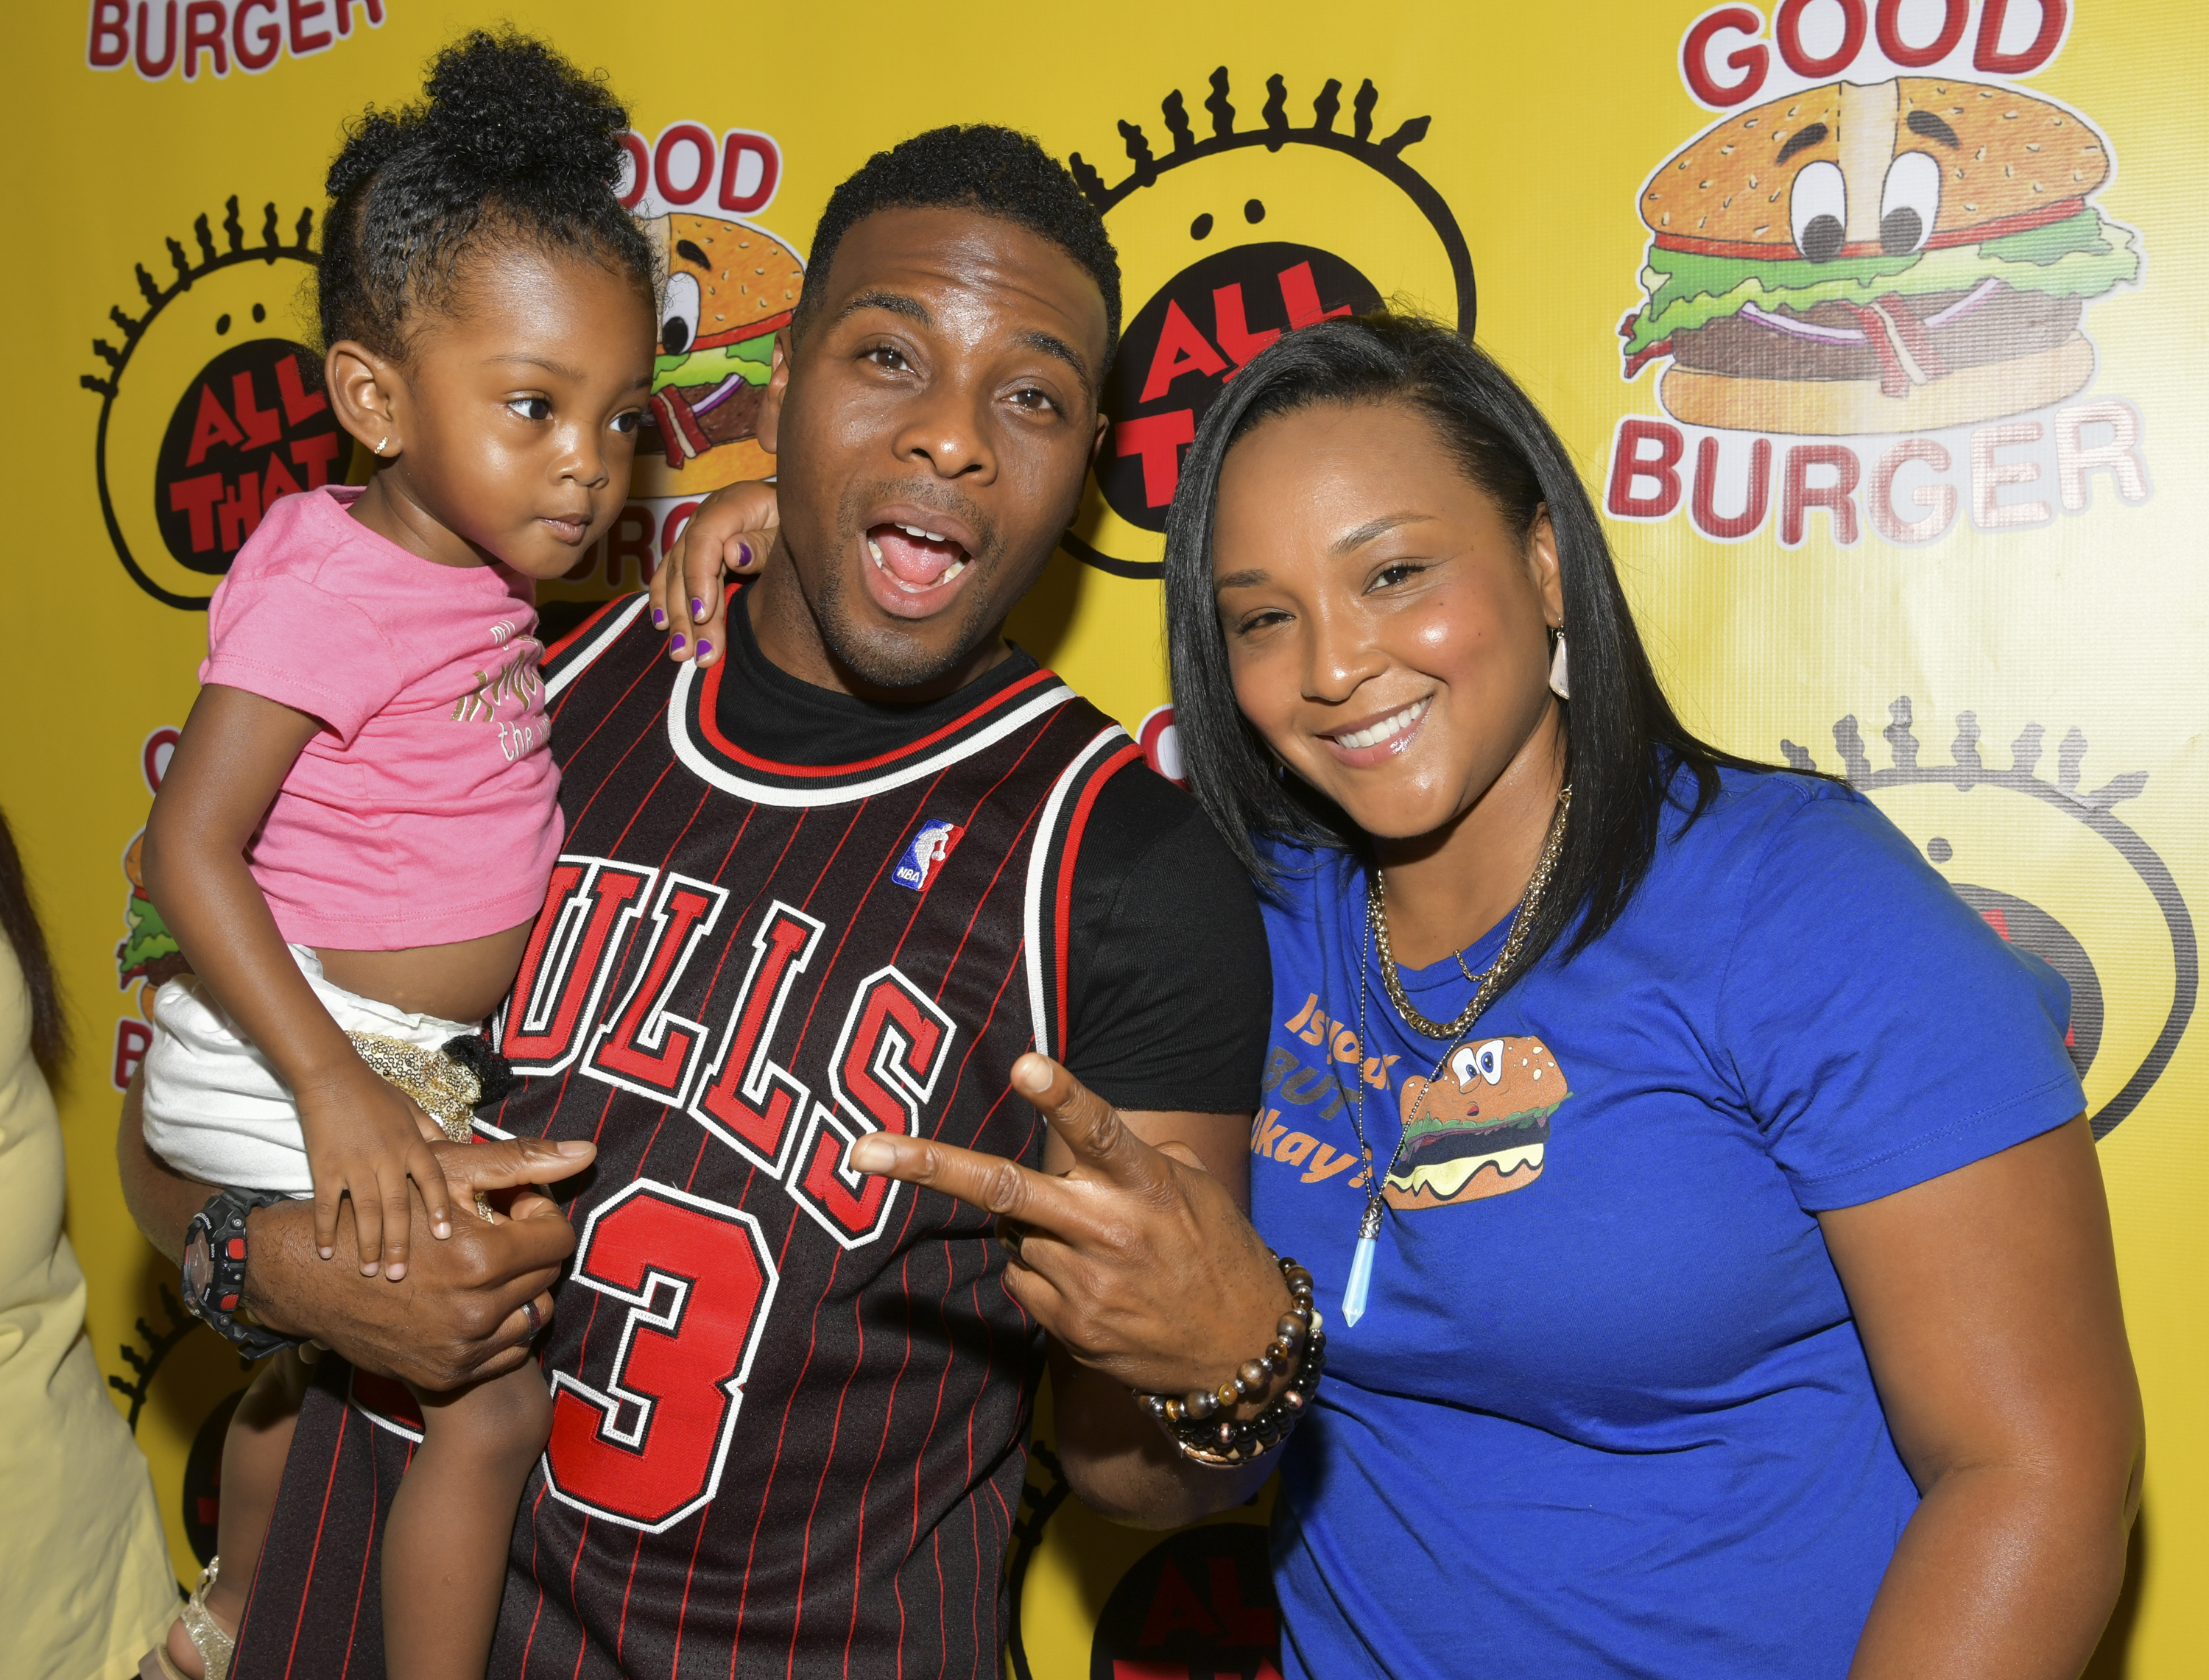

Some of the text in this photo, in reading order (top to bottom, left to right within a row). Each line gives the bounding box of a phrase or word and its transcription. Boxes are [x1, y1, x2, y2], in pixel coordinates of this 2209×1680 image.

[1683, 0, 2068, 107] GOOD
[614, 124, 778, 213] OOD
[1139, 261, 1353, 403] ALL
[186, 354, 327, 467] ALL
[1607, 400, 2148, 546] BURGER
[498, 721, 534, 761] the
[897, 867, 920, 883] NBA
[492, 855, 956, 1251] ULLS
[1284, 992, 1325, 1046] Is
[1261, 1045, 1367, 1120] BUT
[1138, 1556, 1277, 1647] AL
